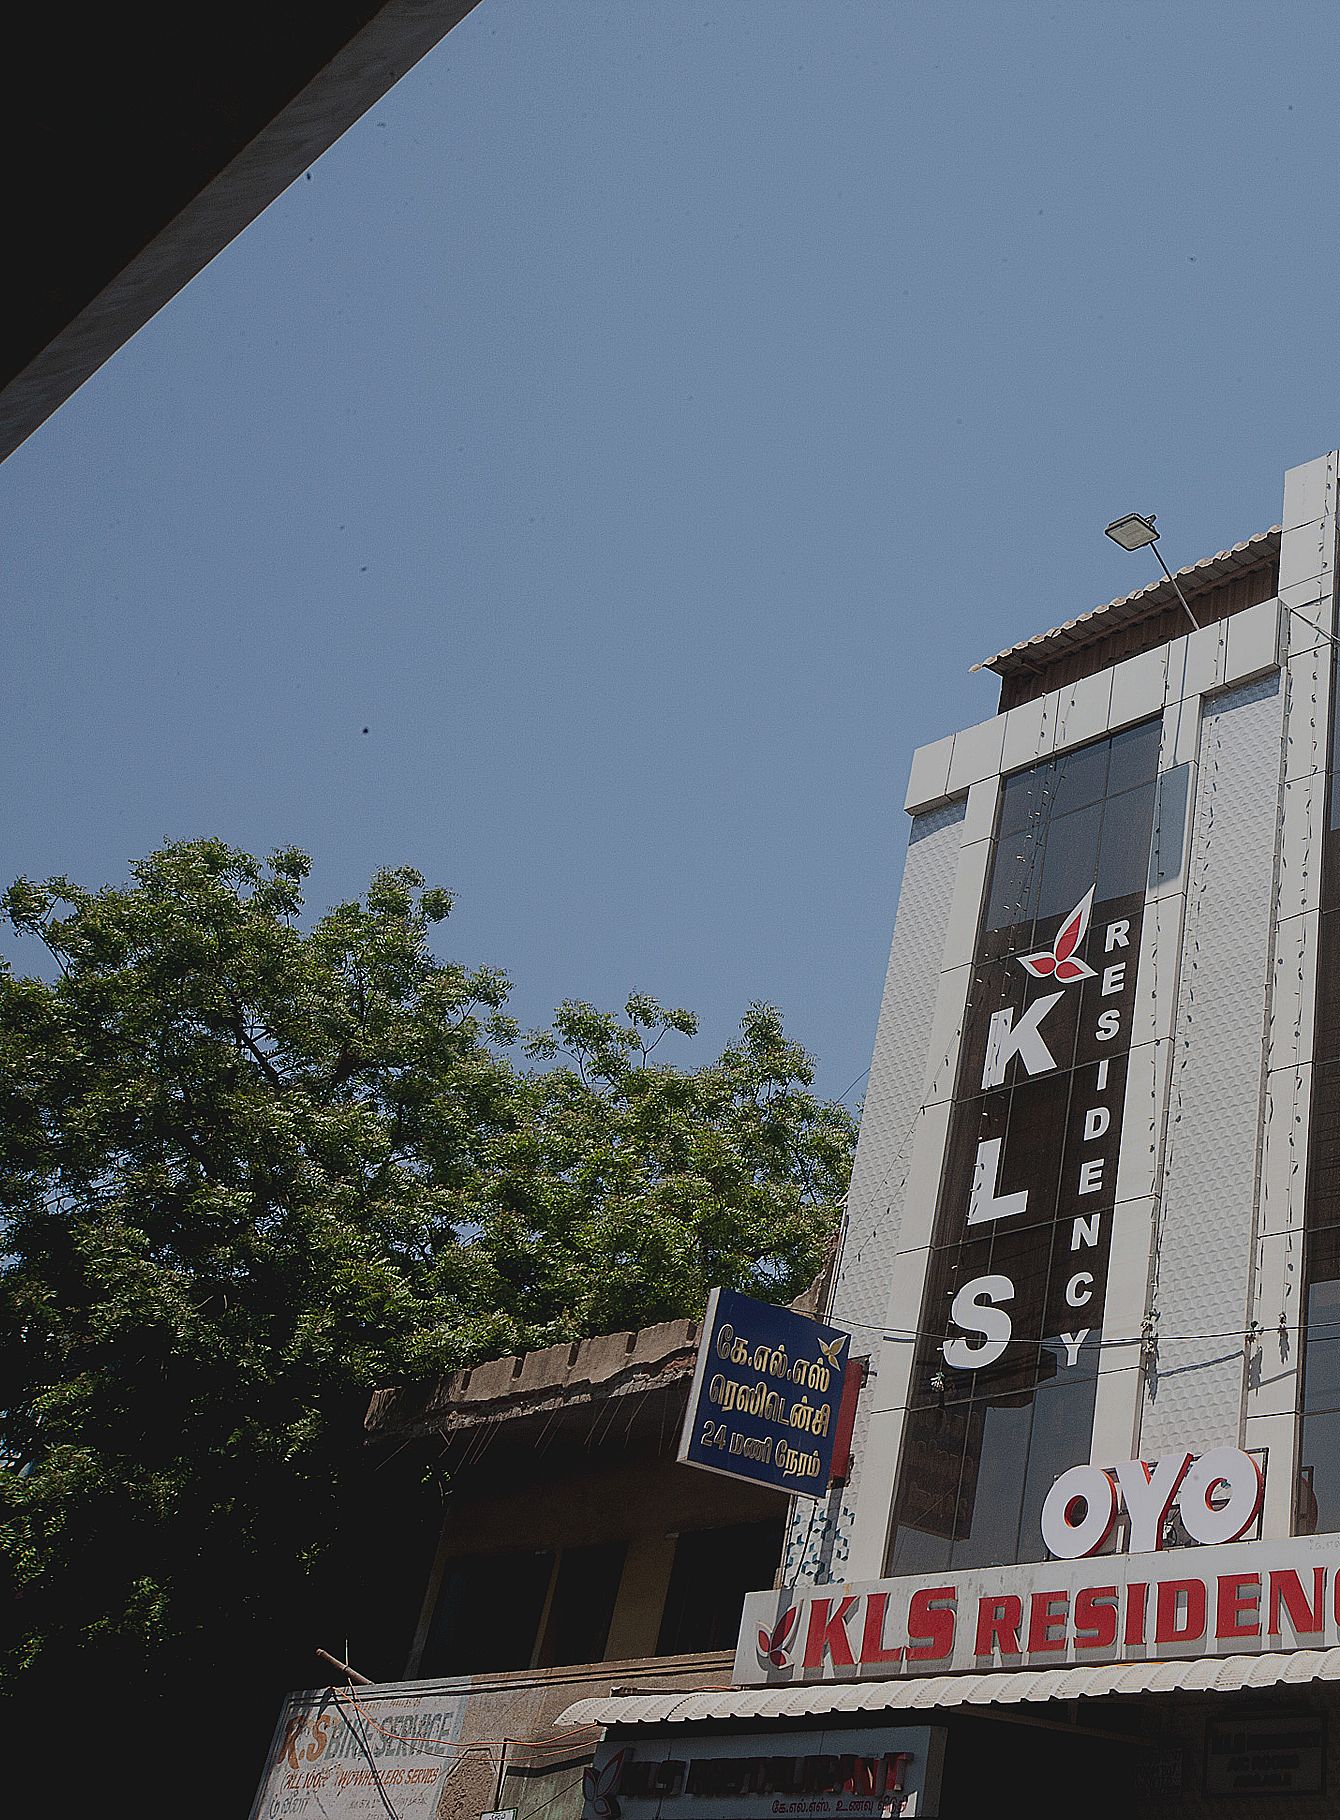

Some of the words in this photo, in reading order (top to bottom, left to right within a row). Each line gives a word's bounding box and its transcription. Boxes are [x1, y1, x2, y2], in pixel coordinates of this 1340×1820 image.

[943, 990, 1066, 1370] KLS
[1059, 919, 1131, 1368] RESIDENCY
[701, 1420, 728, 1451] 24
[729, 1431, 773, 1465] மணி
[774, 1439, 822, 1479] நேரம்
[1040, 1447, 1266, 1559] OYO
[803, 1586, 958, 1668] KLS
